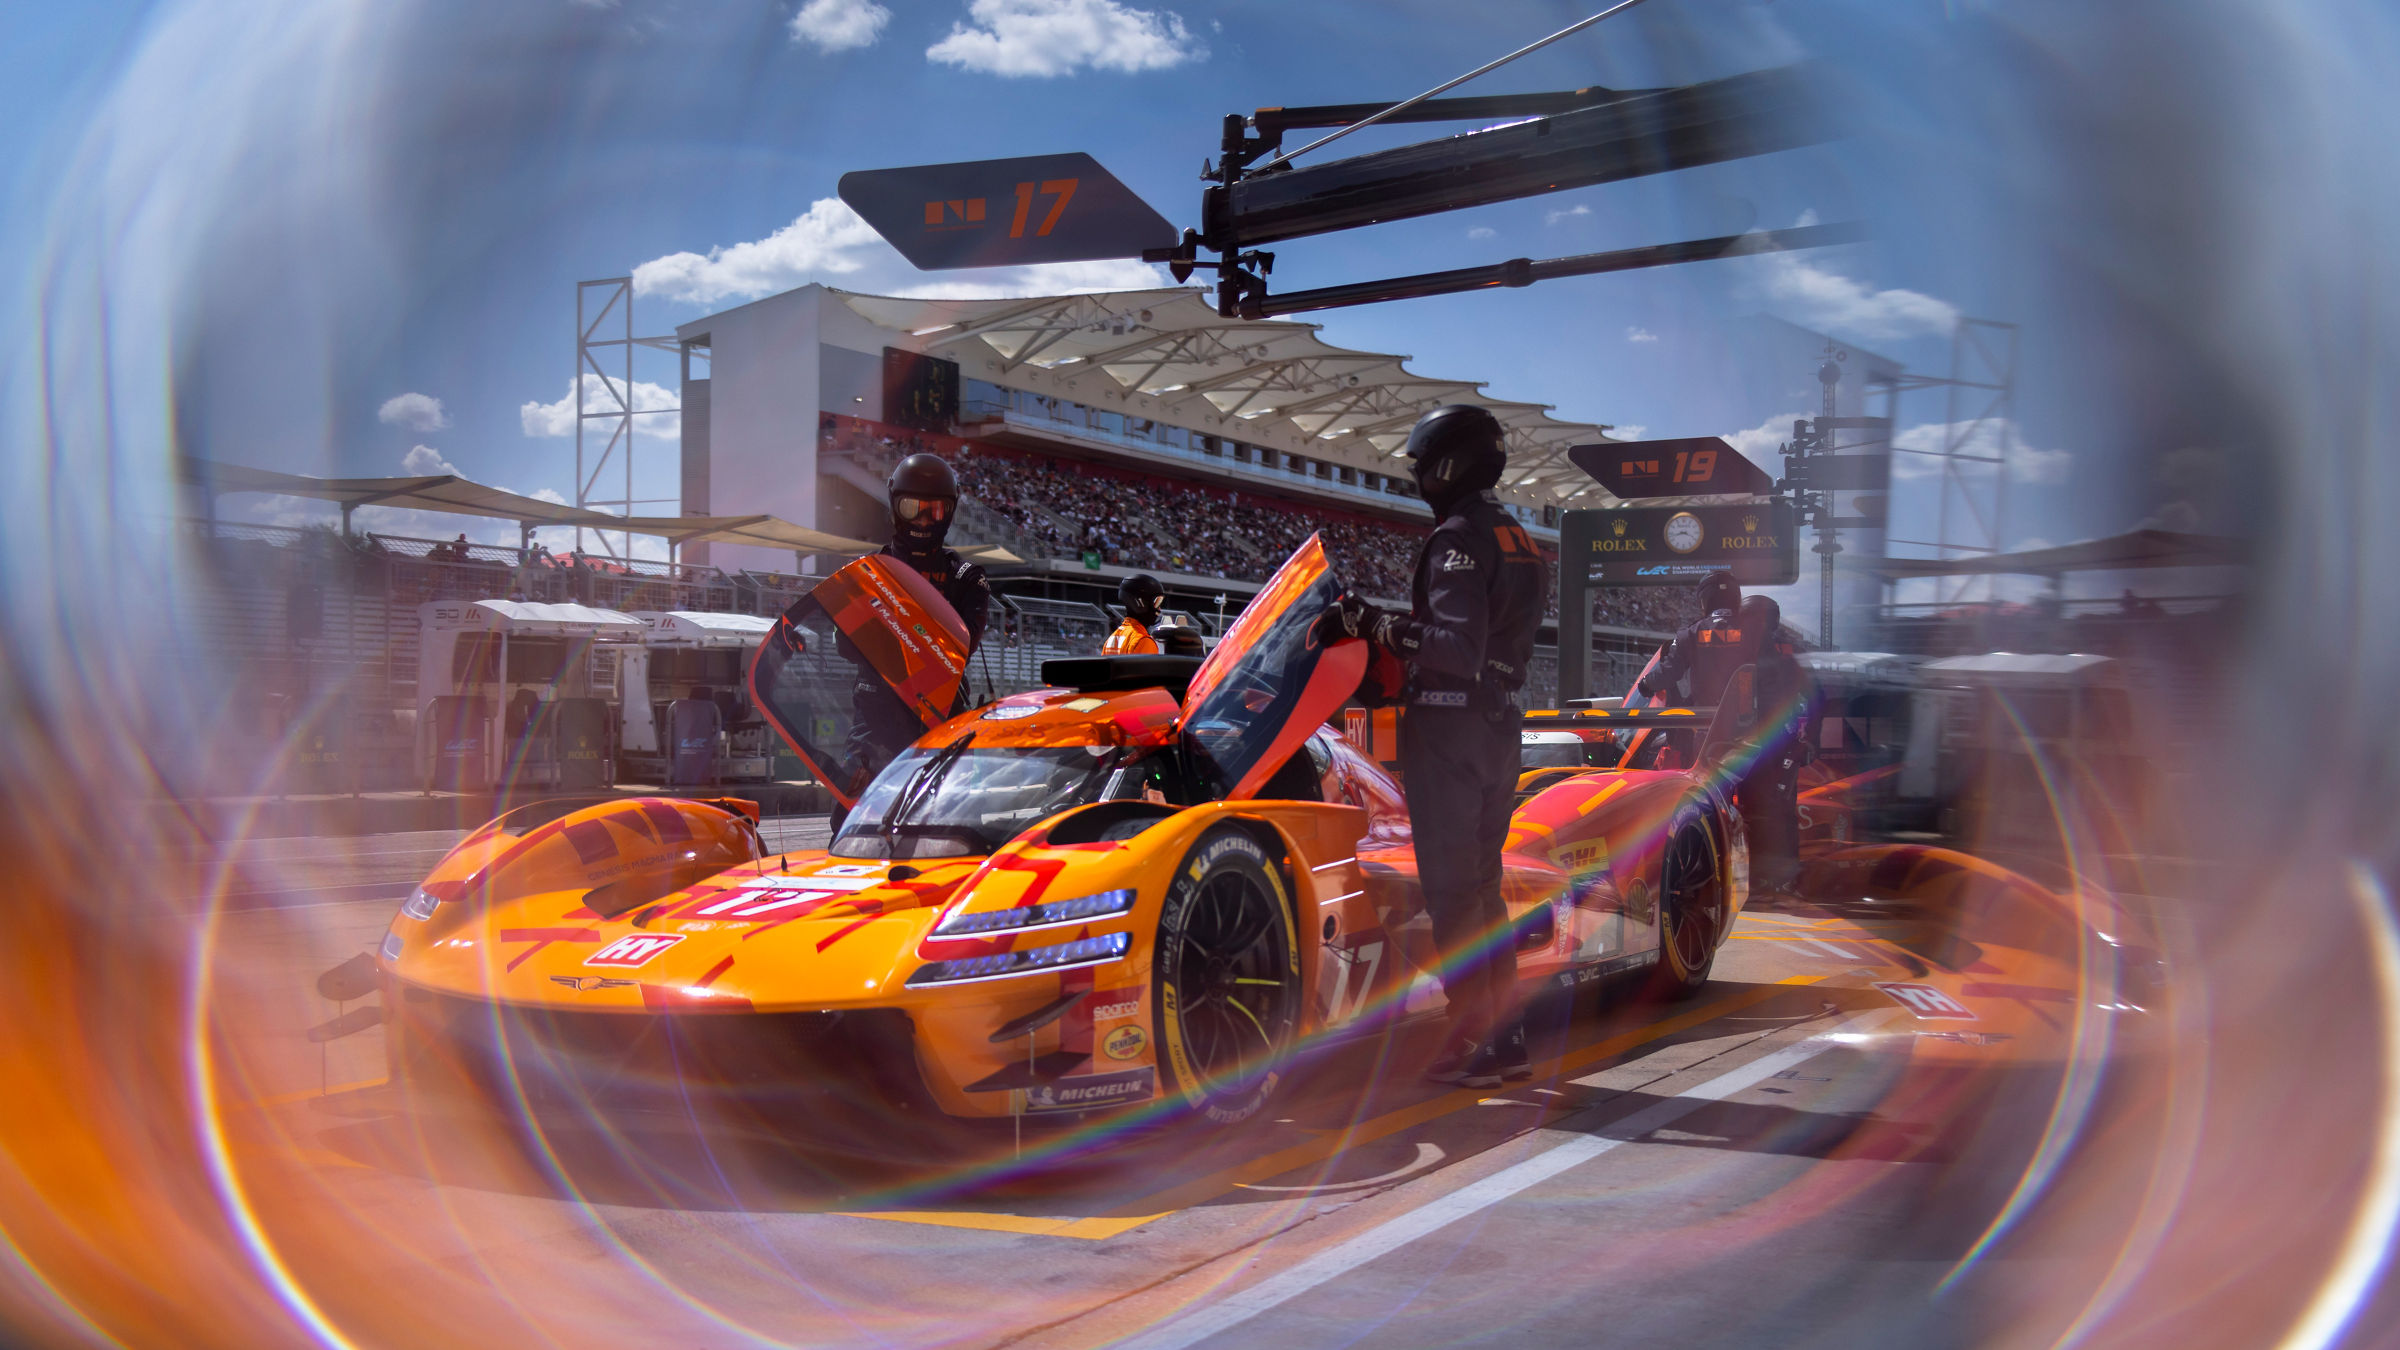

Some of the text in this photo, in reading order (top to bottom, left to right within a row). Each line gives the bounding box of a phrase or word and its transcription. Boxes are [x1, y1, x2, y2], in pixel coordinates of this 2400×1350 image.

[1009, 178, 1079, 239] 17
[1673, 450, 1718, 483] 19
[1592, 539, 1647, 552] ROLEX
[1722, 536, 1779, 549] ROLEX
[876, 581, 911, 617] Lotterer
[1346, 717, 1365, 743] HY
[1209, 836, 1262, 860] MICHELIN
[1559, 846, 1597, 870] DHL
[696, 890, 835, 917] 17
[597, 937, 674, 960] HY
[1325, 940, 1384, 1022] 17
[1093, 1000, 1139, 1021] sparco
[1109, 1032, 1142, 1051] PENNZOIL
[1060, 1080, 1142, 1101] MICHELIN
